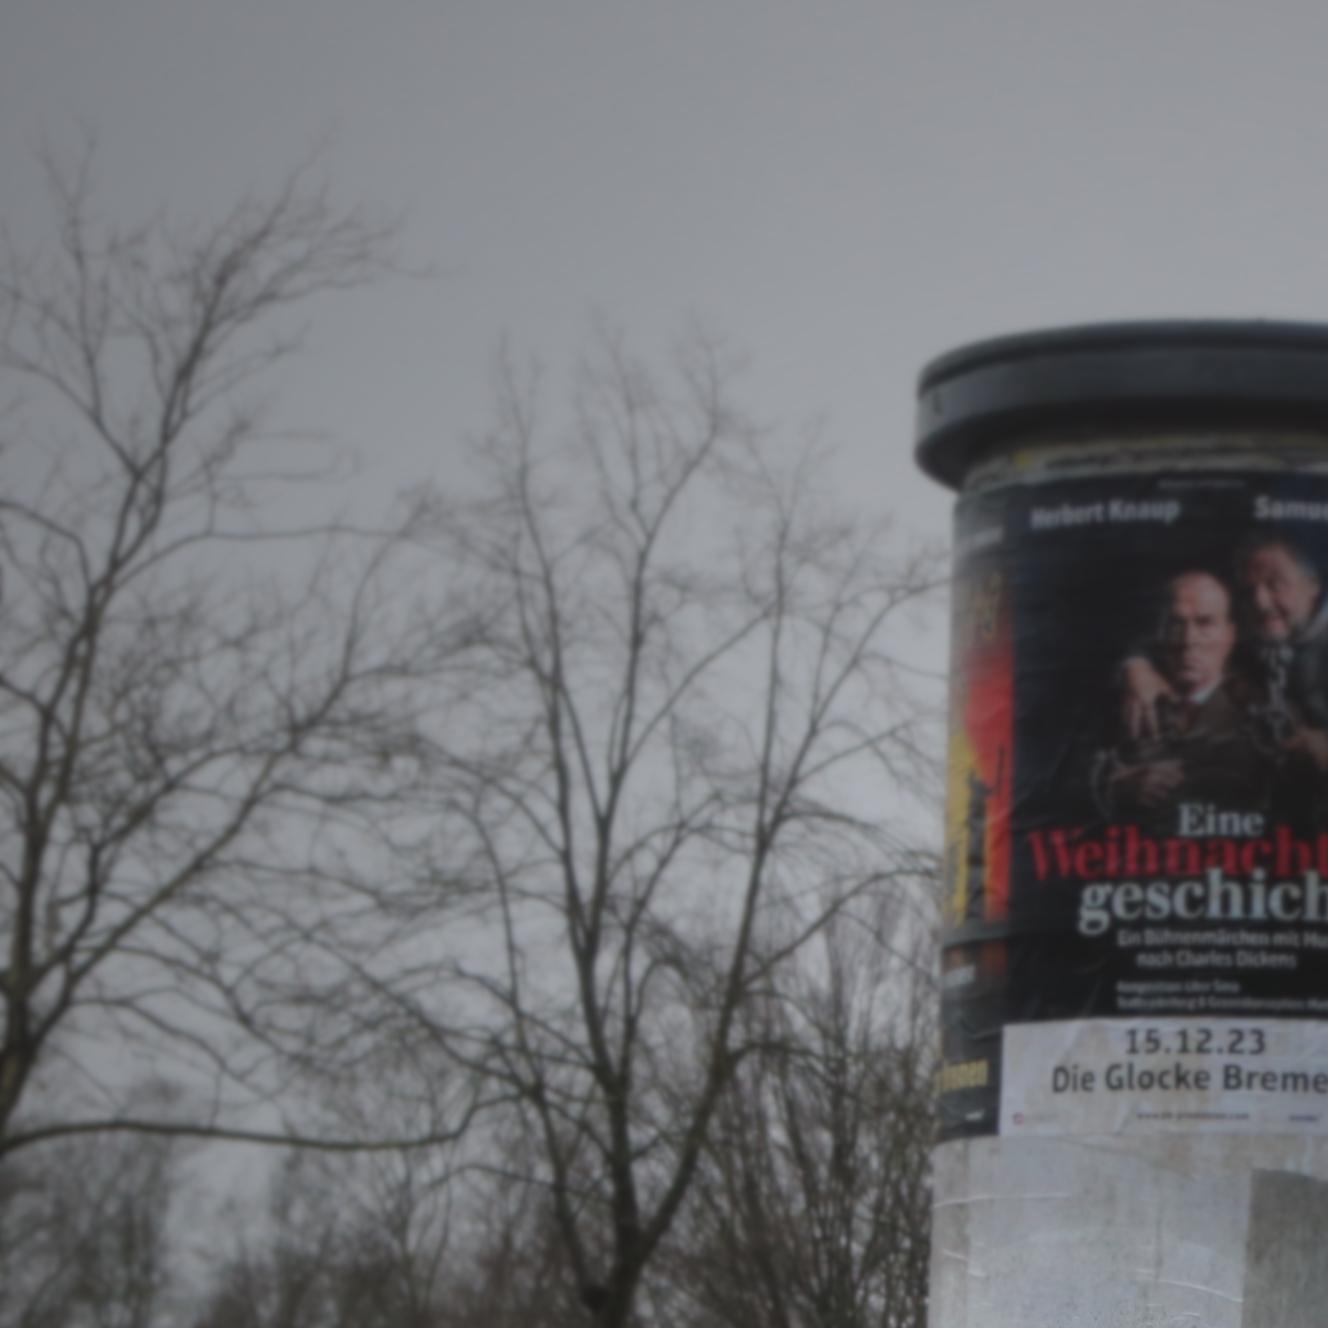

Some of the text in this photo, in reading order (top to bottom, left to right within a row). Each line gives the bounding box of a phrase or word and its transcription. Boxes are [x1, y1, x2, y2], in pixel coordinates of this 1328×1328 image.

[1031, 499, 1183, 529] Herbert Knaup
[1177, 803, 1264, 836] Eine
[1117, 929, 1141, 947] Ein
[1144, 928, 1269, 947] Bühnenmärchen
[1272, 930, 1300, 947] mit
[1136, 950, 1298, 969] nach Charles Dickens
[1125, 1029, 1267, 1055] 15.12.23
[1052, 1066, 1095, 1093] Die
[1105, 1063, 1211, 1092] Glocke
